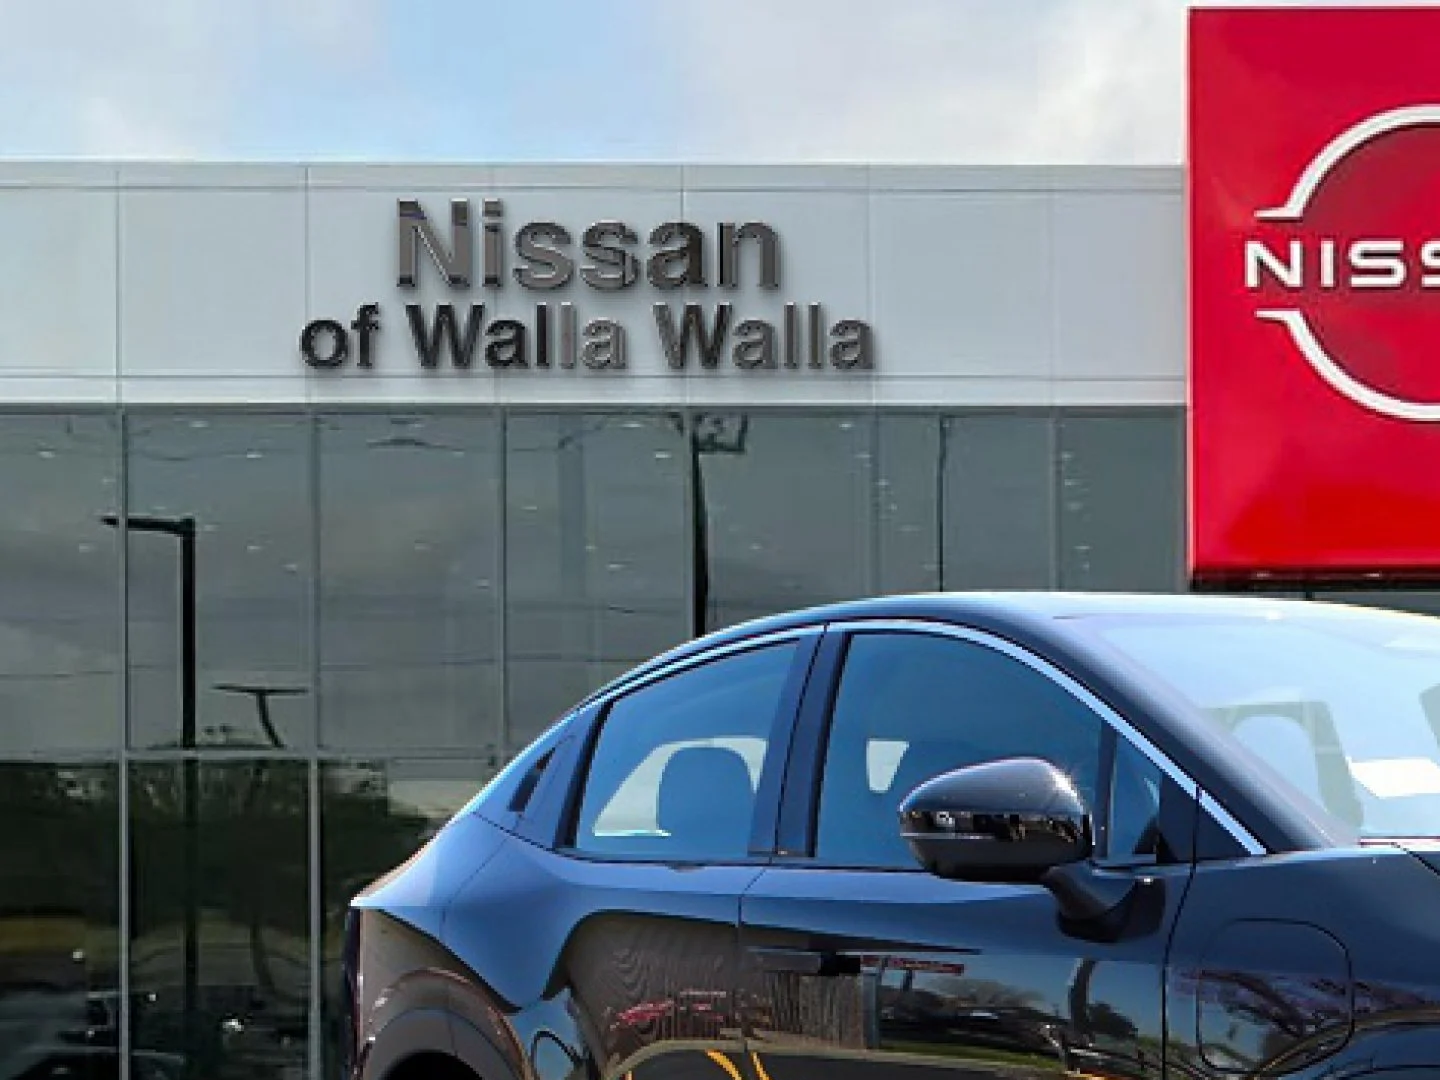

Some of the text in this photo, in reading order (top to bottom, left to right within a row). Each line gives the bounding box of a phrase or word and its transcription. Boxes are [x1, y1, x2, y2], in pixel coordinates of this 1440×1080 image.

[397, 198, 781, 288] Nissan
[299, 302, 874, 369] of Walla Walla
